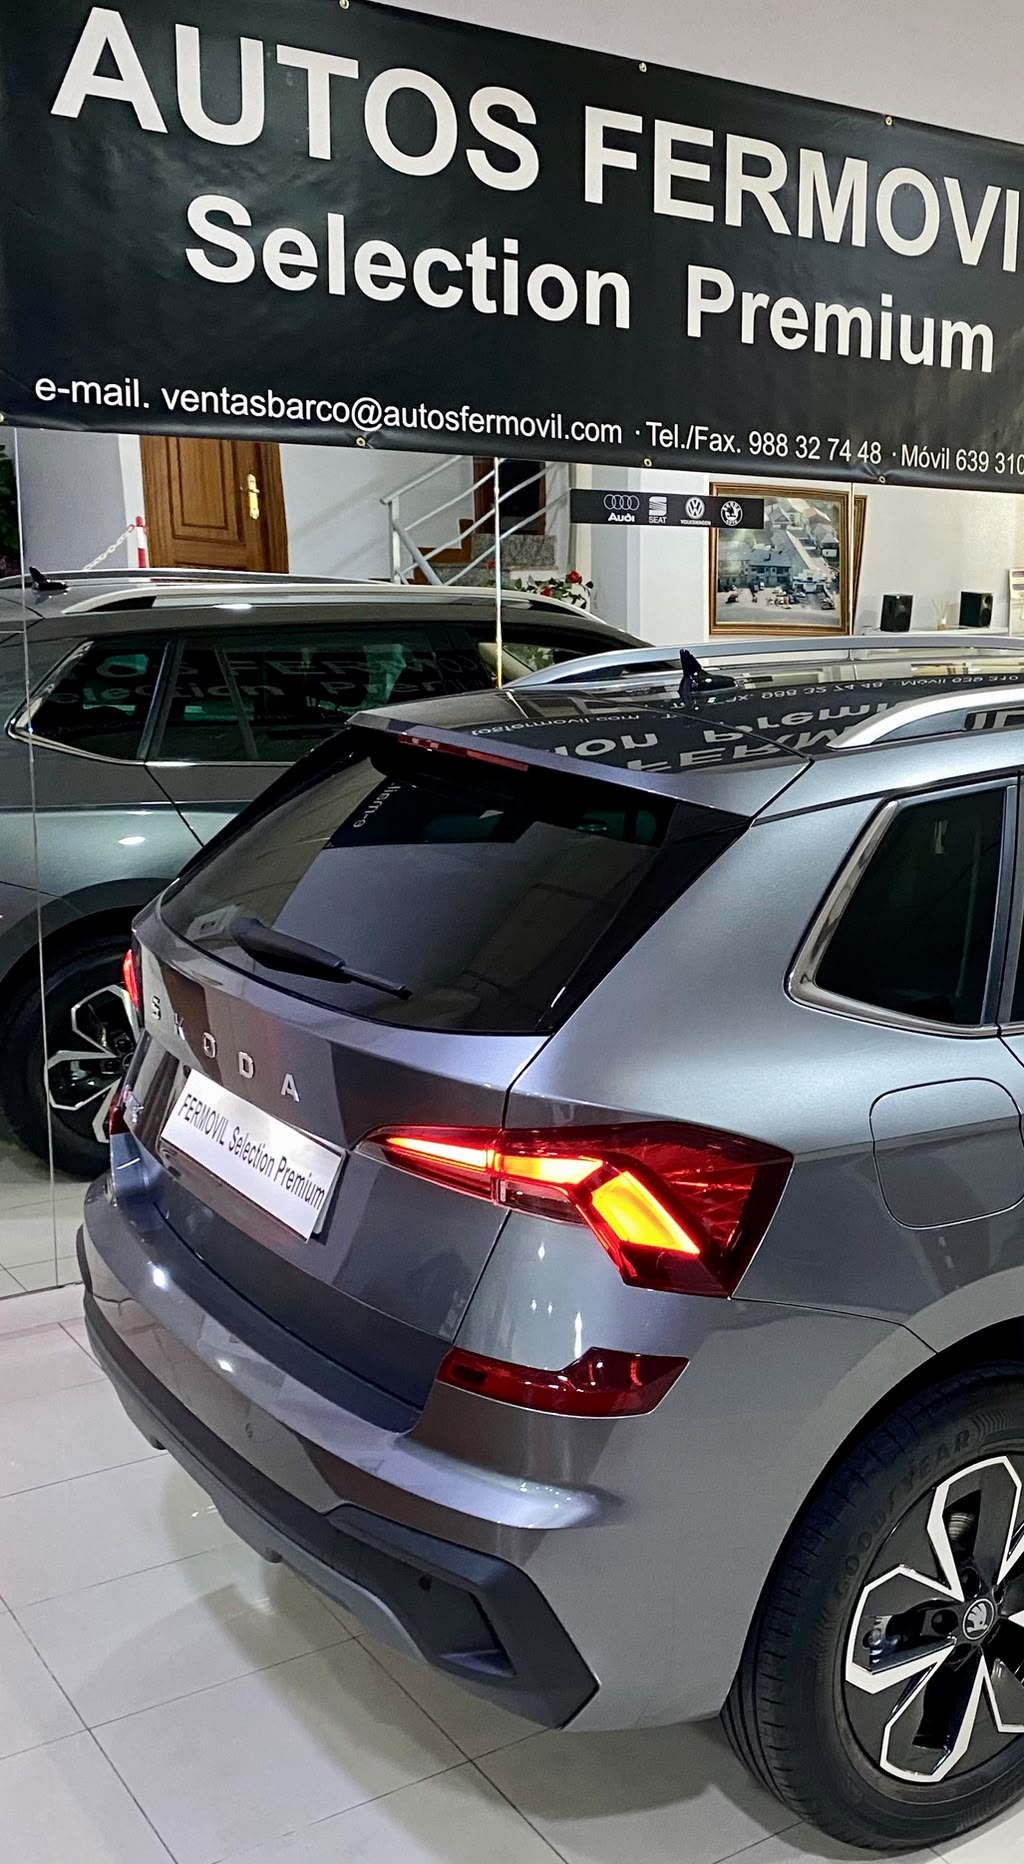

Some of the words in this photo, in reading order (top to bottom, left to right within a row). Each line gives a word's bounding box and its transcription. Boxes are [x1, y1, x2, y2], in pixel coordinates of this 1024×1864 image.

[50, 6, 540, 192] AUTOS
[185, 194, 630, 330] Selection
[687, 265, 994, 373] Premium
[35, 378, 150, 409] e-mail.
[161, 385, 622, 444] ventasbarco@autosfermovil.com
[748, 430, 789, 457] 988
[795, 434, 821, 460] 32
[827, 437, 852, 462] 74
[857, 440, 882, 465] 48
[901, 444, 950, 470] Móvil
[955, 448, 989, 473] 639
[607, 512, 636, 523] Audi
[648, 516, 668, 524] SEAT
[177, 1093, 230, 1147] FERMOVIL
[228, 1125, 276, 1178] Selection
[273, 1155, 326, 1211] Premium
